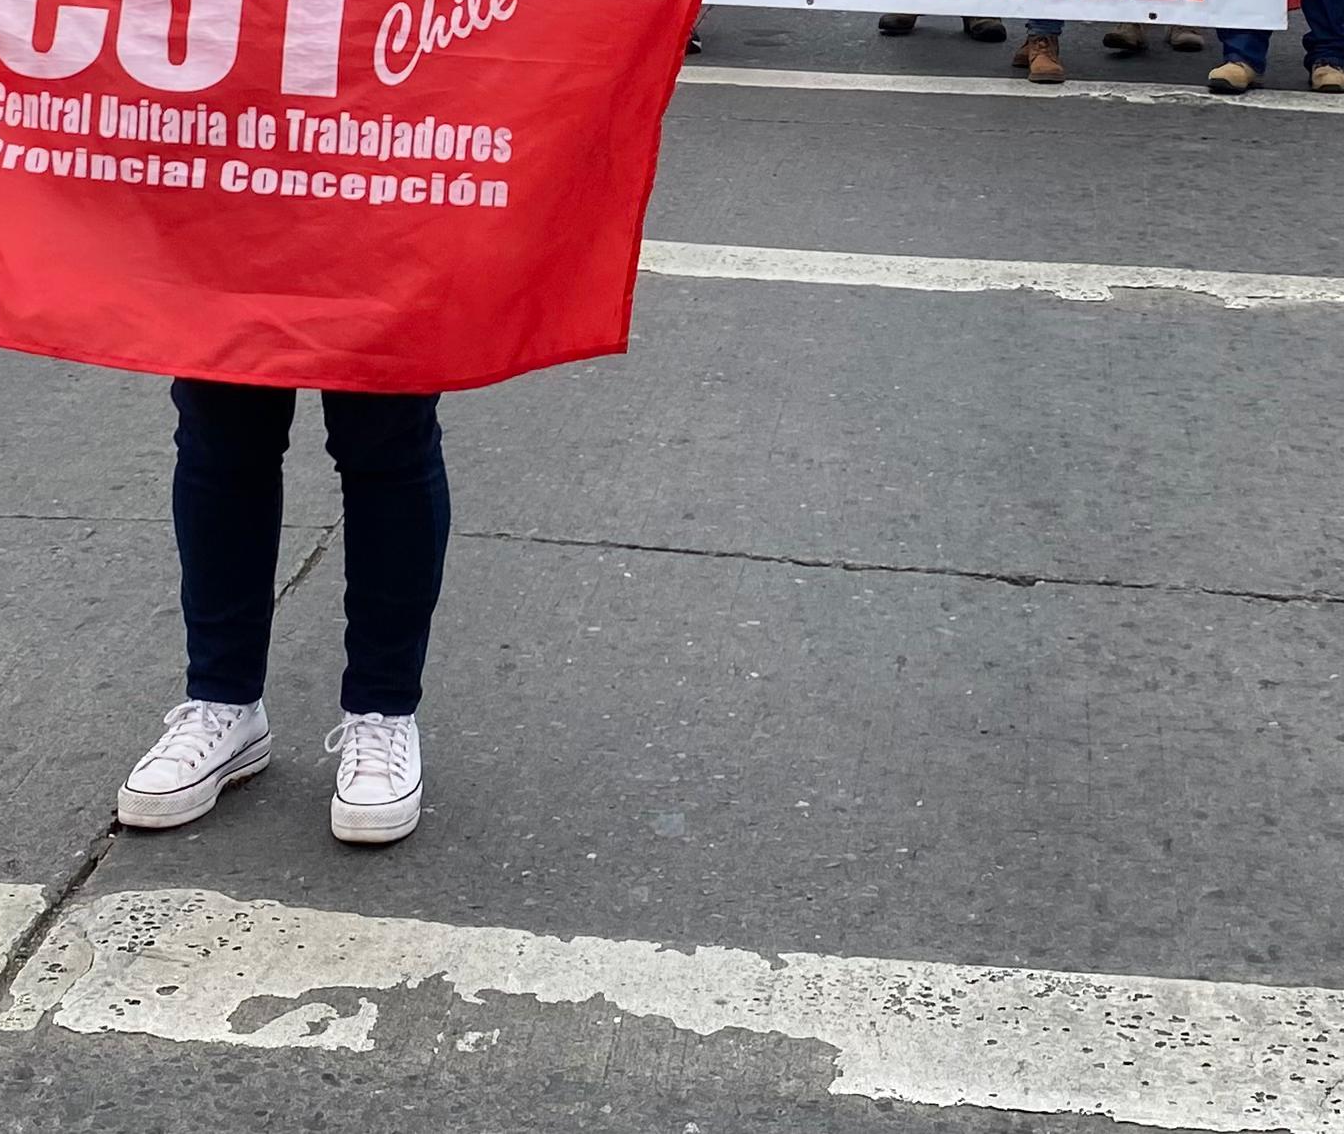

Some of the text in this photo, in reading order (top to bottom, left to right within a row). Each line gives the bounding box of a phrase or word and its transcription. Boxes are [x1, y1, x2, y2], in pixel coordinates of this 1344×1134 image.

[100, 95, 228, 148] Unitaria
[237, 106, 277, 151] de
[286, 109, 513, 164] Trabajadores
[219, 159, 509, 208] Concepción
